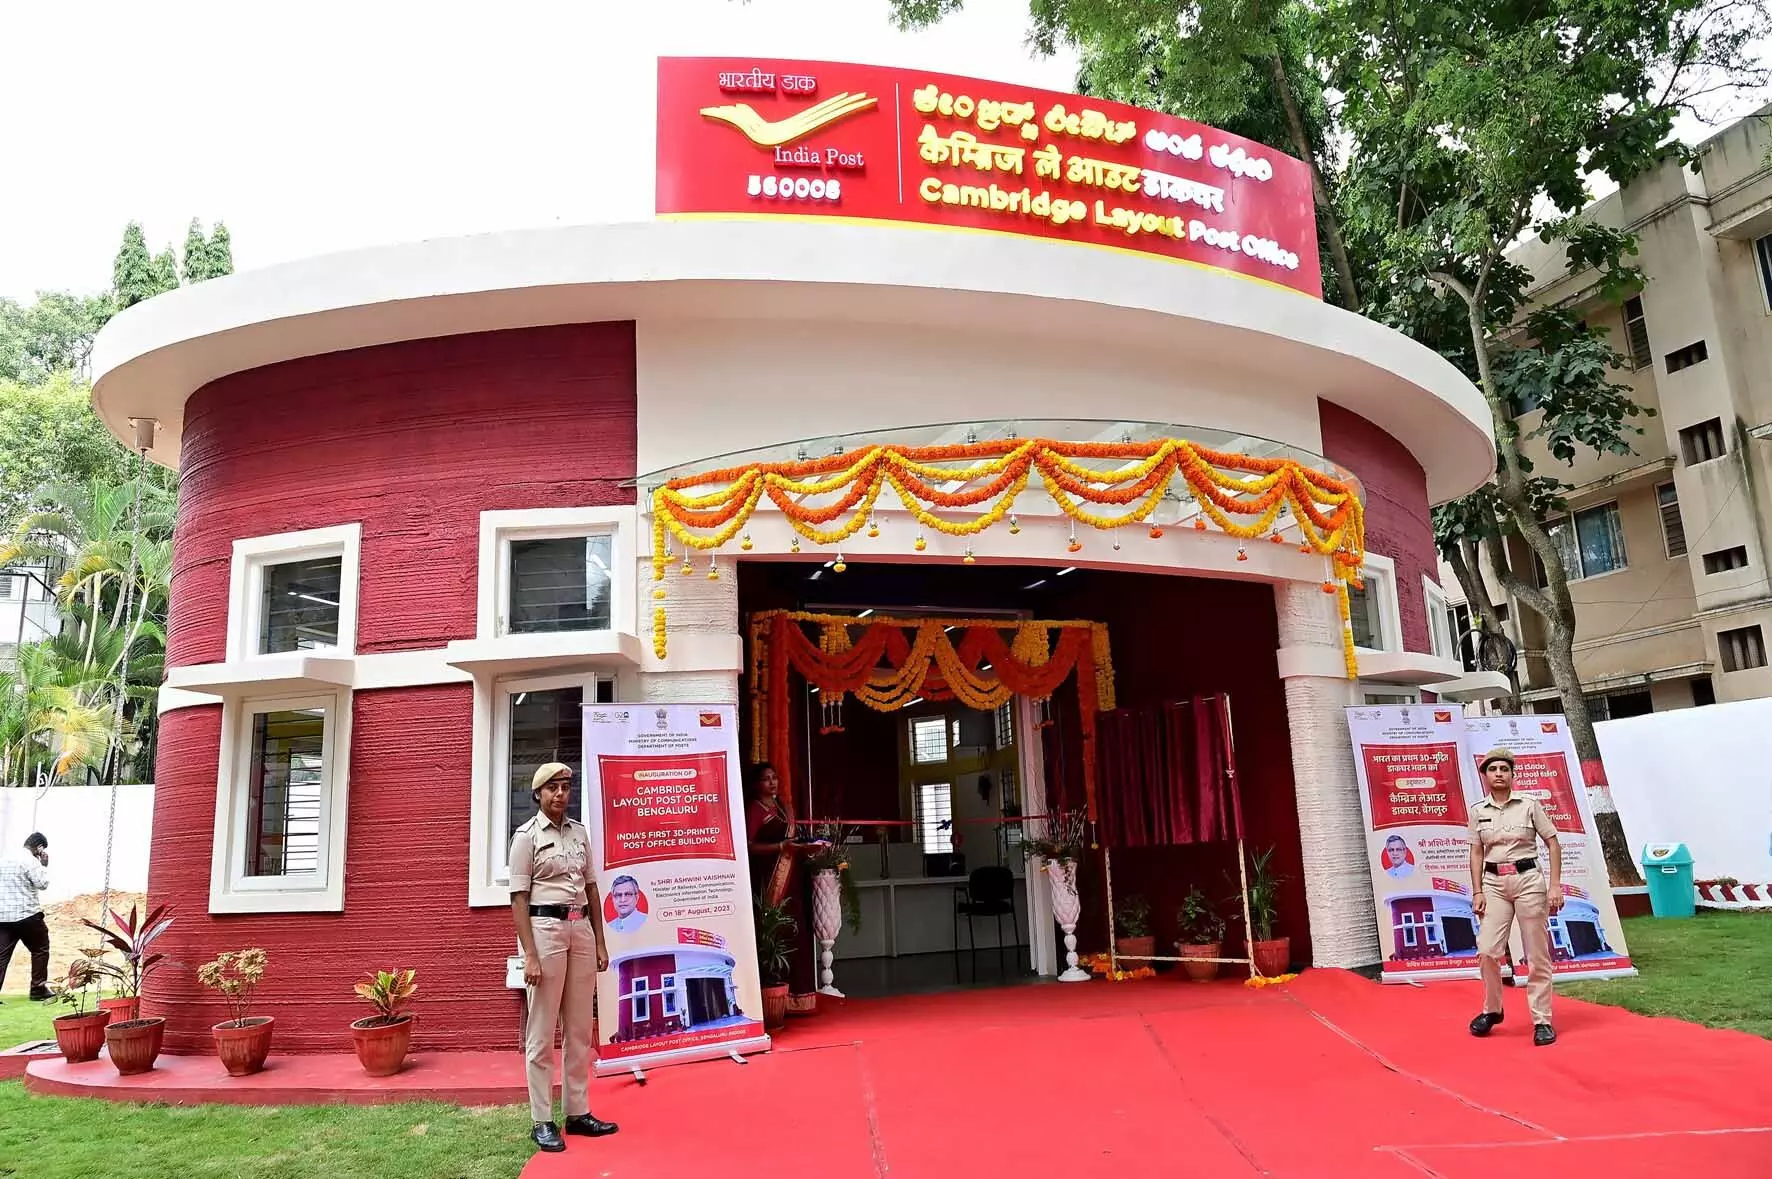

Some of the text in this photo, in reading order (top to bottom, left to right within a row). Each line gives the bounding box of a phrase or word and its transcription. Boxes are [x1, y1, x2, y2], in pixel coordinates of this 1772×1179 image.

[719, 67, 817, 91] भारतीय डाक
[775, 145, 865, 167] India Post
[747, 174, 841, 200] 560008
[1141, 168, 1225, 213] डाकघर
[919, 177, 1300, 270] Cambridge Layout Post Office
[637, 784, 696, 795] CAMBRIDGE
[613, 793, 719, 808] LAYOUT POST OFFICE
[637, 805, 698, 817] BENGALURU
[616, 827, 720, 841] INDIA'S FIRST 3D-PRINTED
[623, 836, 717, 849] POST OFFICE BUILDING
[674, 876, 702, 884] ASHWINI
[702, 873, 736, 881] VAISHNAW
[713, 905, 730, 913] 2023
